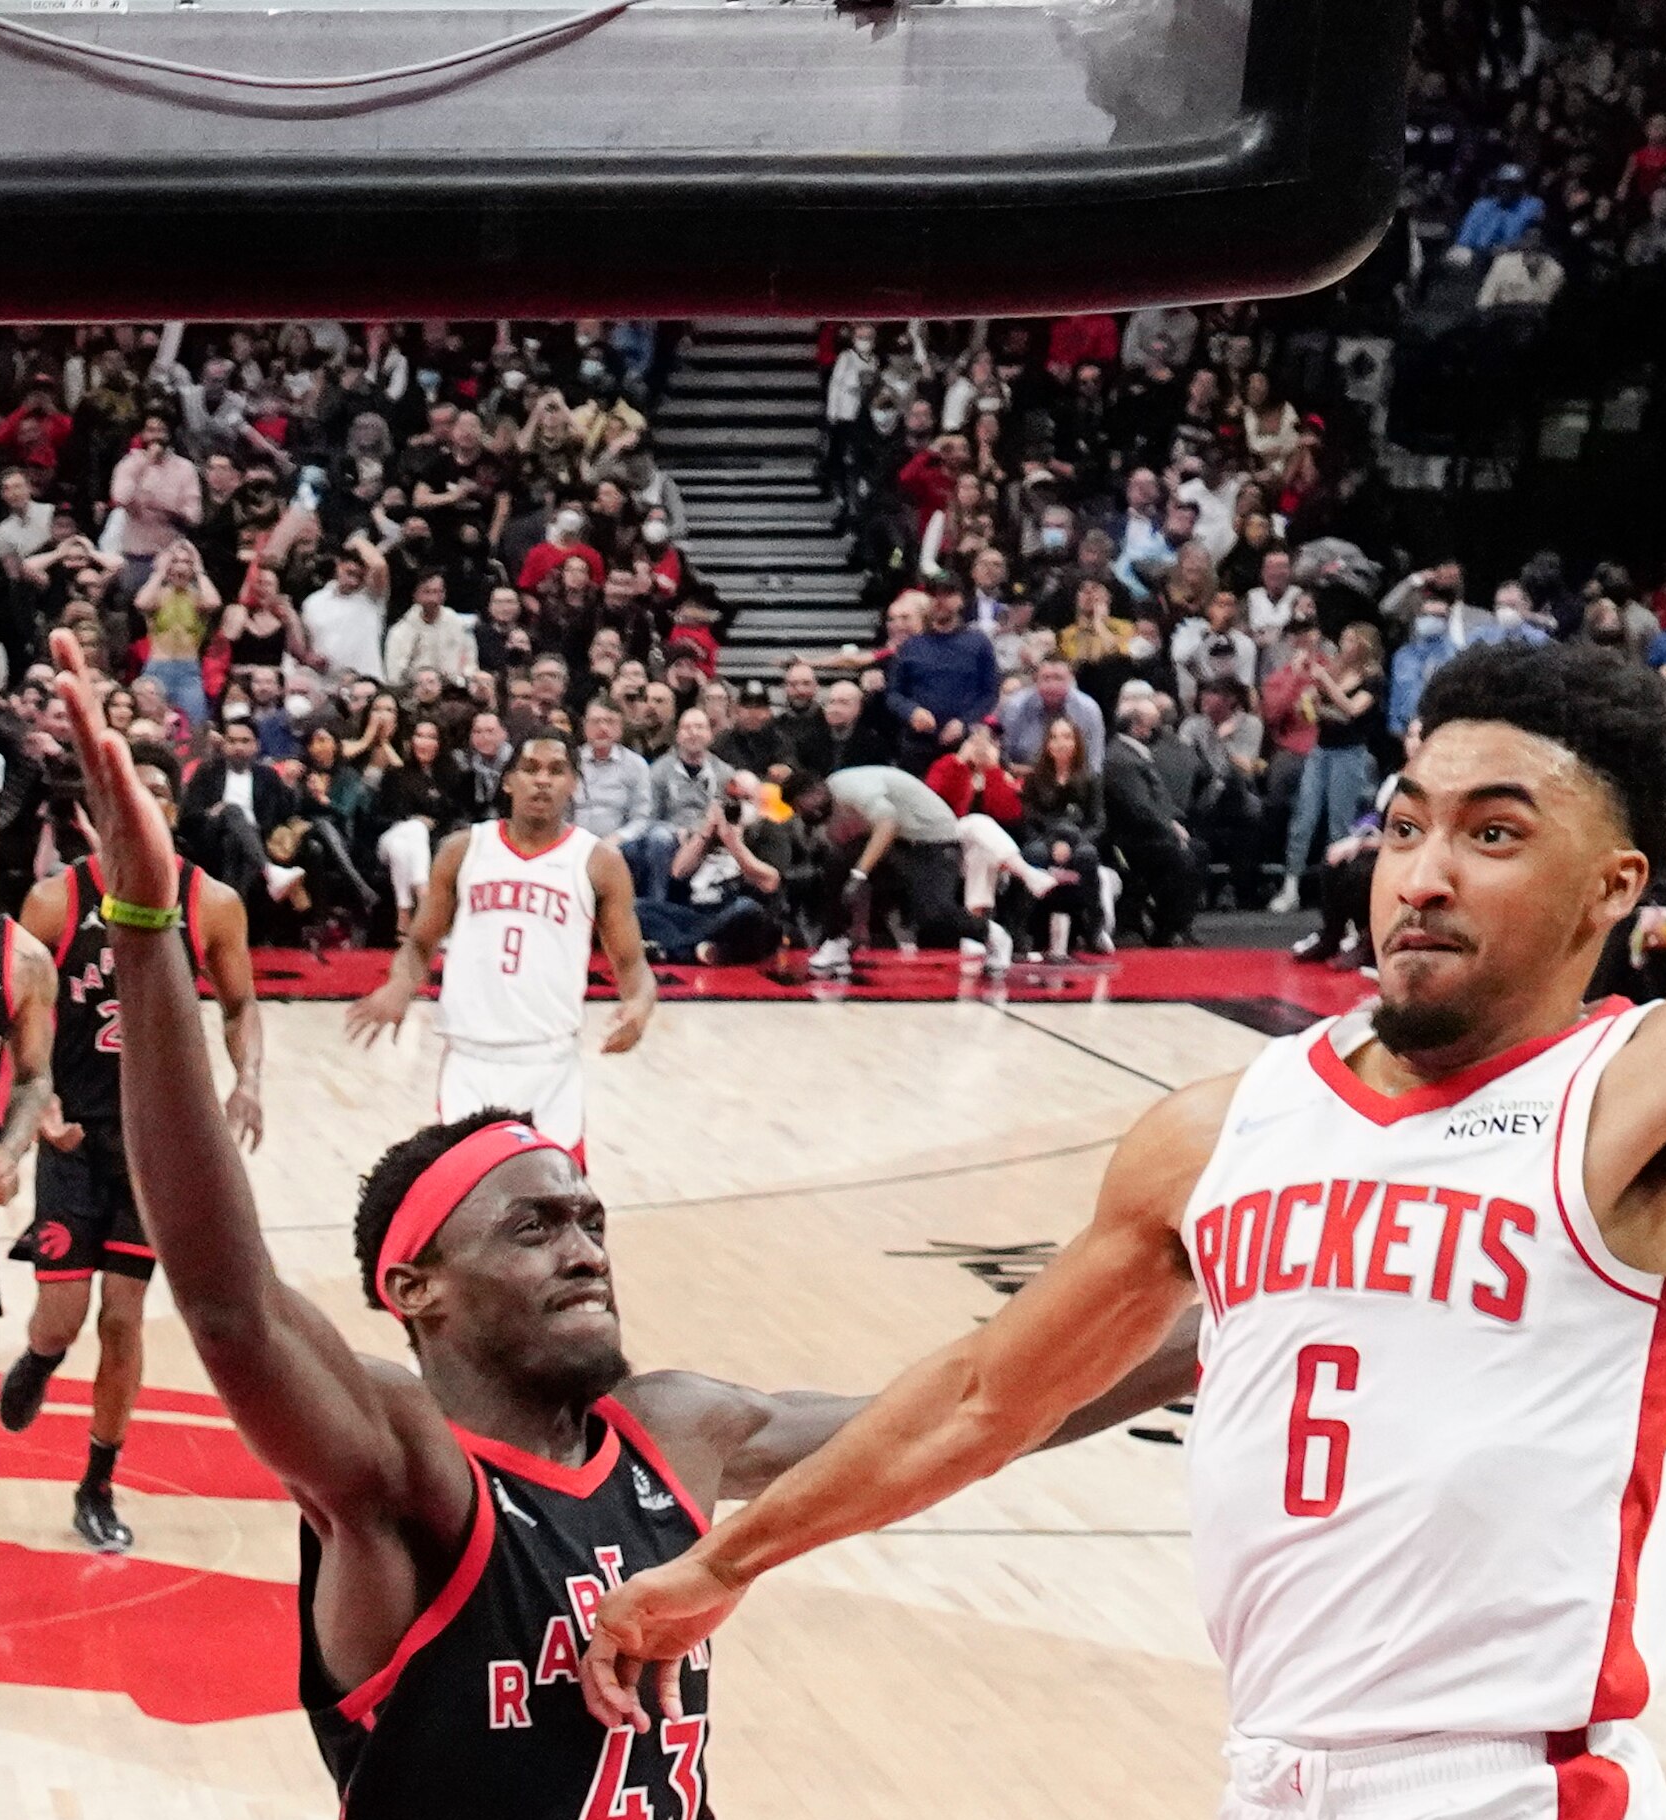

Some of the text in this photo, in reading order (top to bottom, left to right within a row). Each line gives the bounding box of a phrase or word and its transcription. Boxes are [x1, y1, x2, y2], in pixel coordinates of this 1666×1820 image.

[469, 880, 572, 925] ROCKETS
[501, 927, 523, 974] 9
[1444, 1113, 1550, 1140] MONEY
[1195, 1177, 1538, 1328] ROCKETS
[1282, 1343, 1360, 1518] 6
